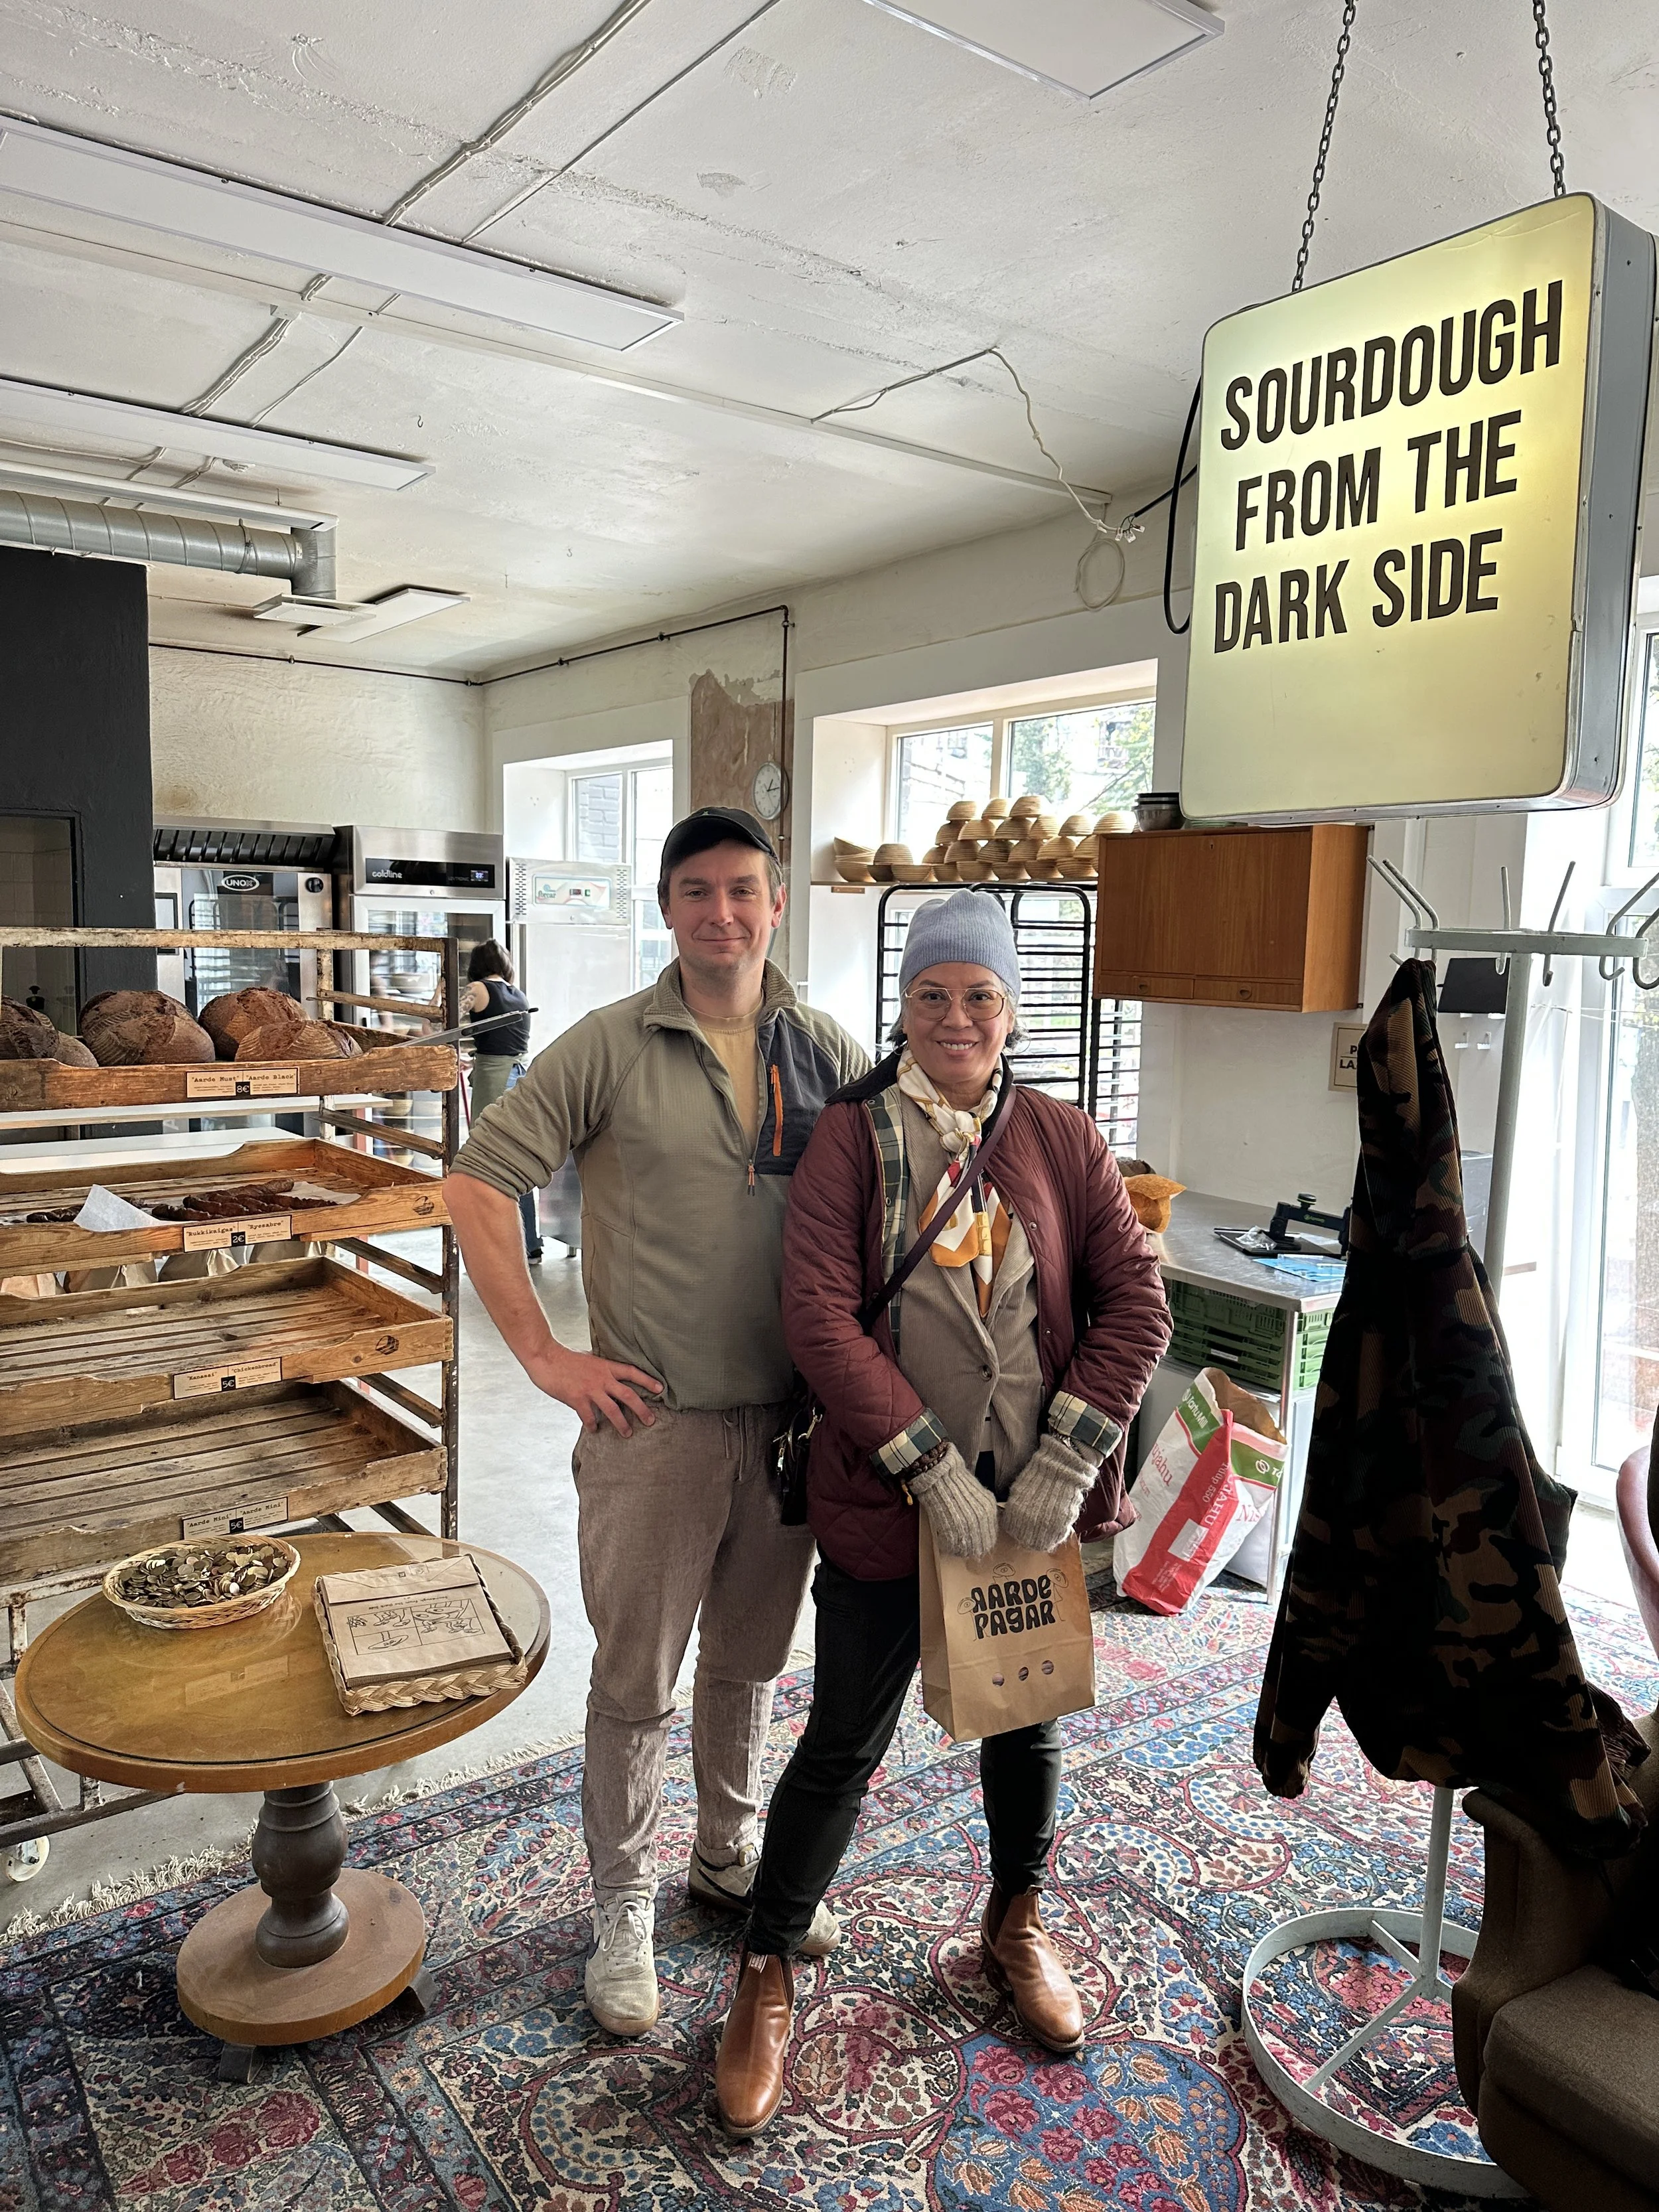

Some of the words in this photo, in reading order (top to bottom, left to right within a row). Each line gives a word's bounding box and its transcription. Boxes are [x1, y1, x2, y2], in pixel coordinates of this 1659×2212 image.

[1221, 279, 1562, 450] SOURDOUGH
[1236, 447, 1381, 551] FROM
[1407, 409, 1521, 513] THE
[1214, 559, 1350, 653] DARK
[1372, 528, 1502, 627] SIDE
[372, 869, 403, 878] coldline
[1339, 1059, 1357, 1070] LA
[232, 1234, 245, 1243] 2€
[1202, 1485, 1216, 1503] 550
